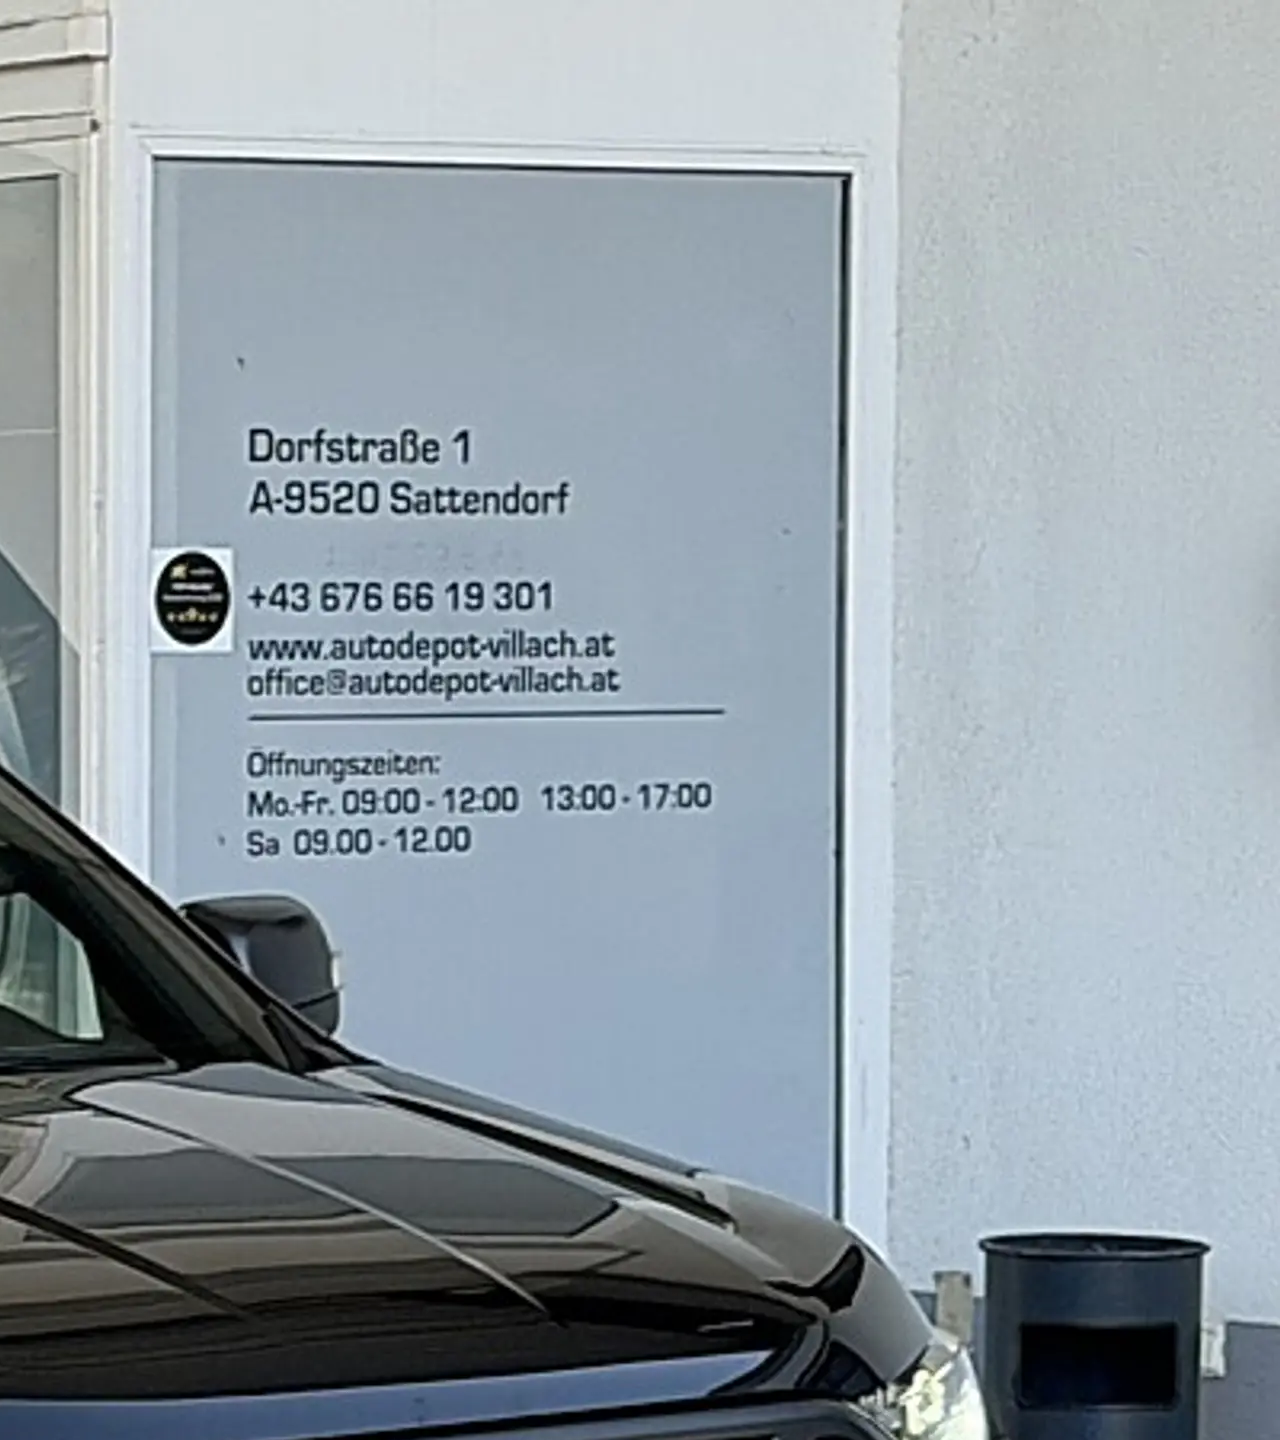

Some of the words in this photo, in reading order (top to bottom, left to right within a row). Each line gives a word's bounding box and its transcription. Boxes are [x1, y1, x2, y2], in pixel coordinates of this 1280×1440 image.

[248, 428, 441, 464] Dorfstraße
[452, 429, 471, 464] 1
[249, 480, 380, 515] A-9520
[389, 481, 569, 515] Sattendorf
[248, 582, 310, 612] +43
[319, 582, 383, 612] 676
[393, 582, 434, 612] 66
[444, 582, 485, 612] 19
[493, 581, 552, 611] 301
[248, 629, 615, 667] www.autodepot-villach.at
[247, 666, 620, 701] office@autodepot-villach.at
[247, 748, 441, 782] Öffnungszeiten:
[248, 790, 335, 817] Mo.-Fr.
[445, 786, 520, 813] 12:00
[541, 784, 618, 811] 13:00
[638, 783, 713, 809] 17:00
[247, 831, 280, 856] Sa
